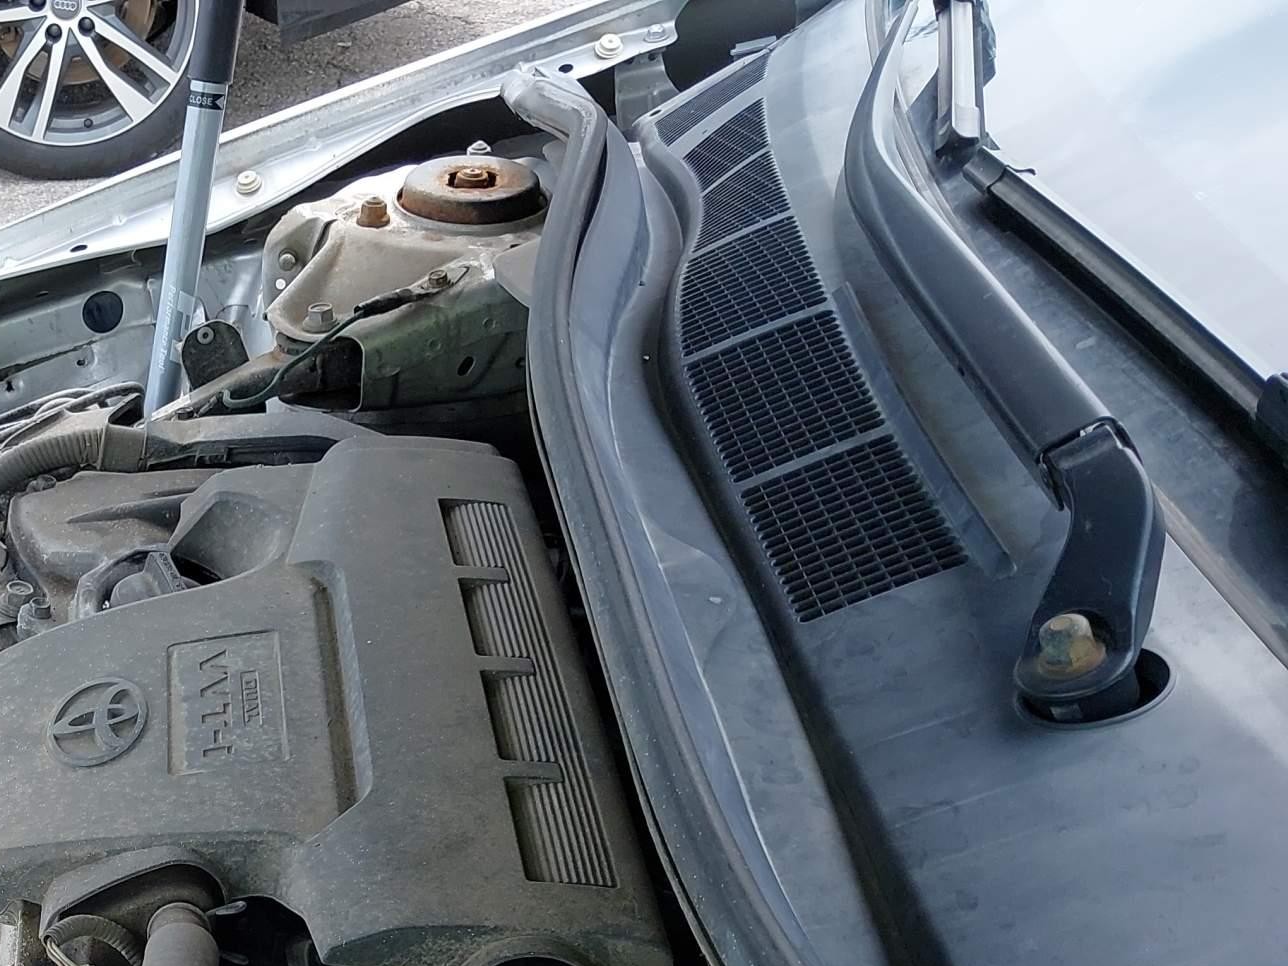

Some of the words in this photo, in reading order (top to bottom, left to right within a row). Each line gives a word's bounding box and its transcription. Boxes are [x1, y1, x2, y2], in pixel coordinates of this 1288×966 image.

[189, 94, 213, 106] CLOSE
[200, 649, 234, 758] VVT-i
[244, 679, 261, 725] DUAL
